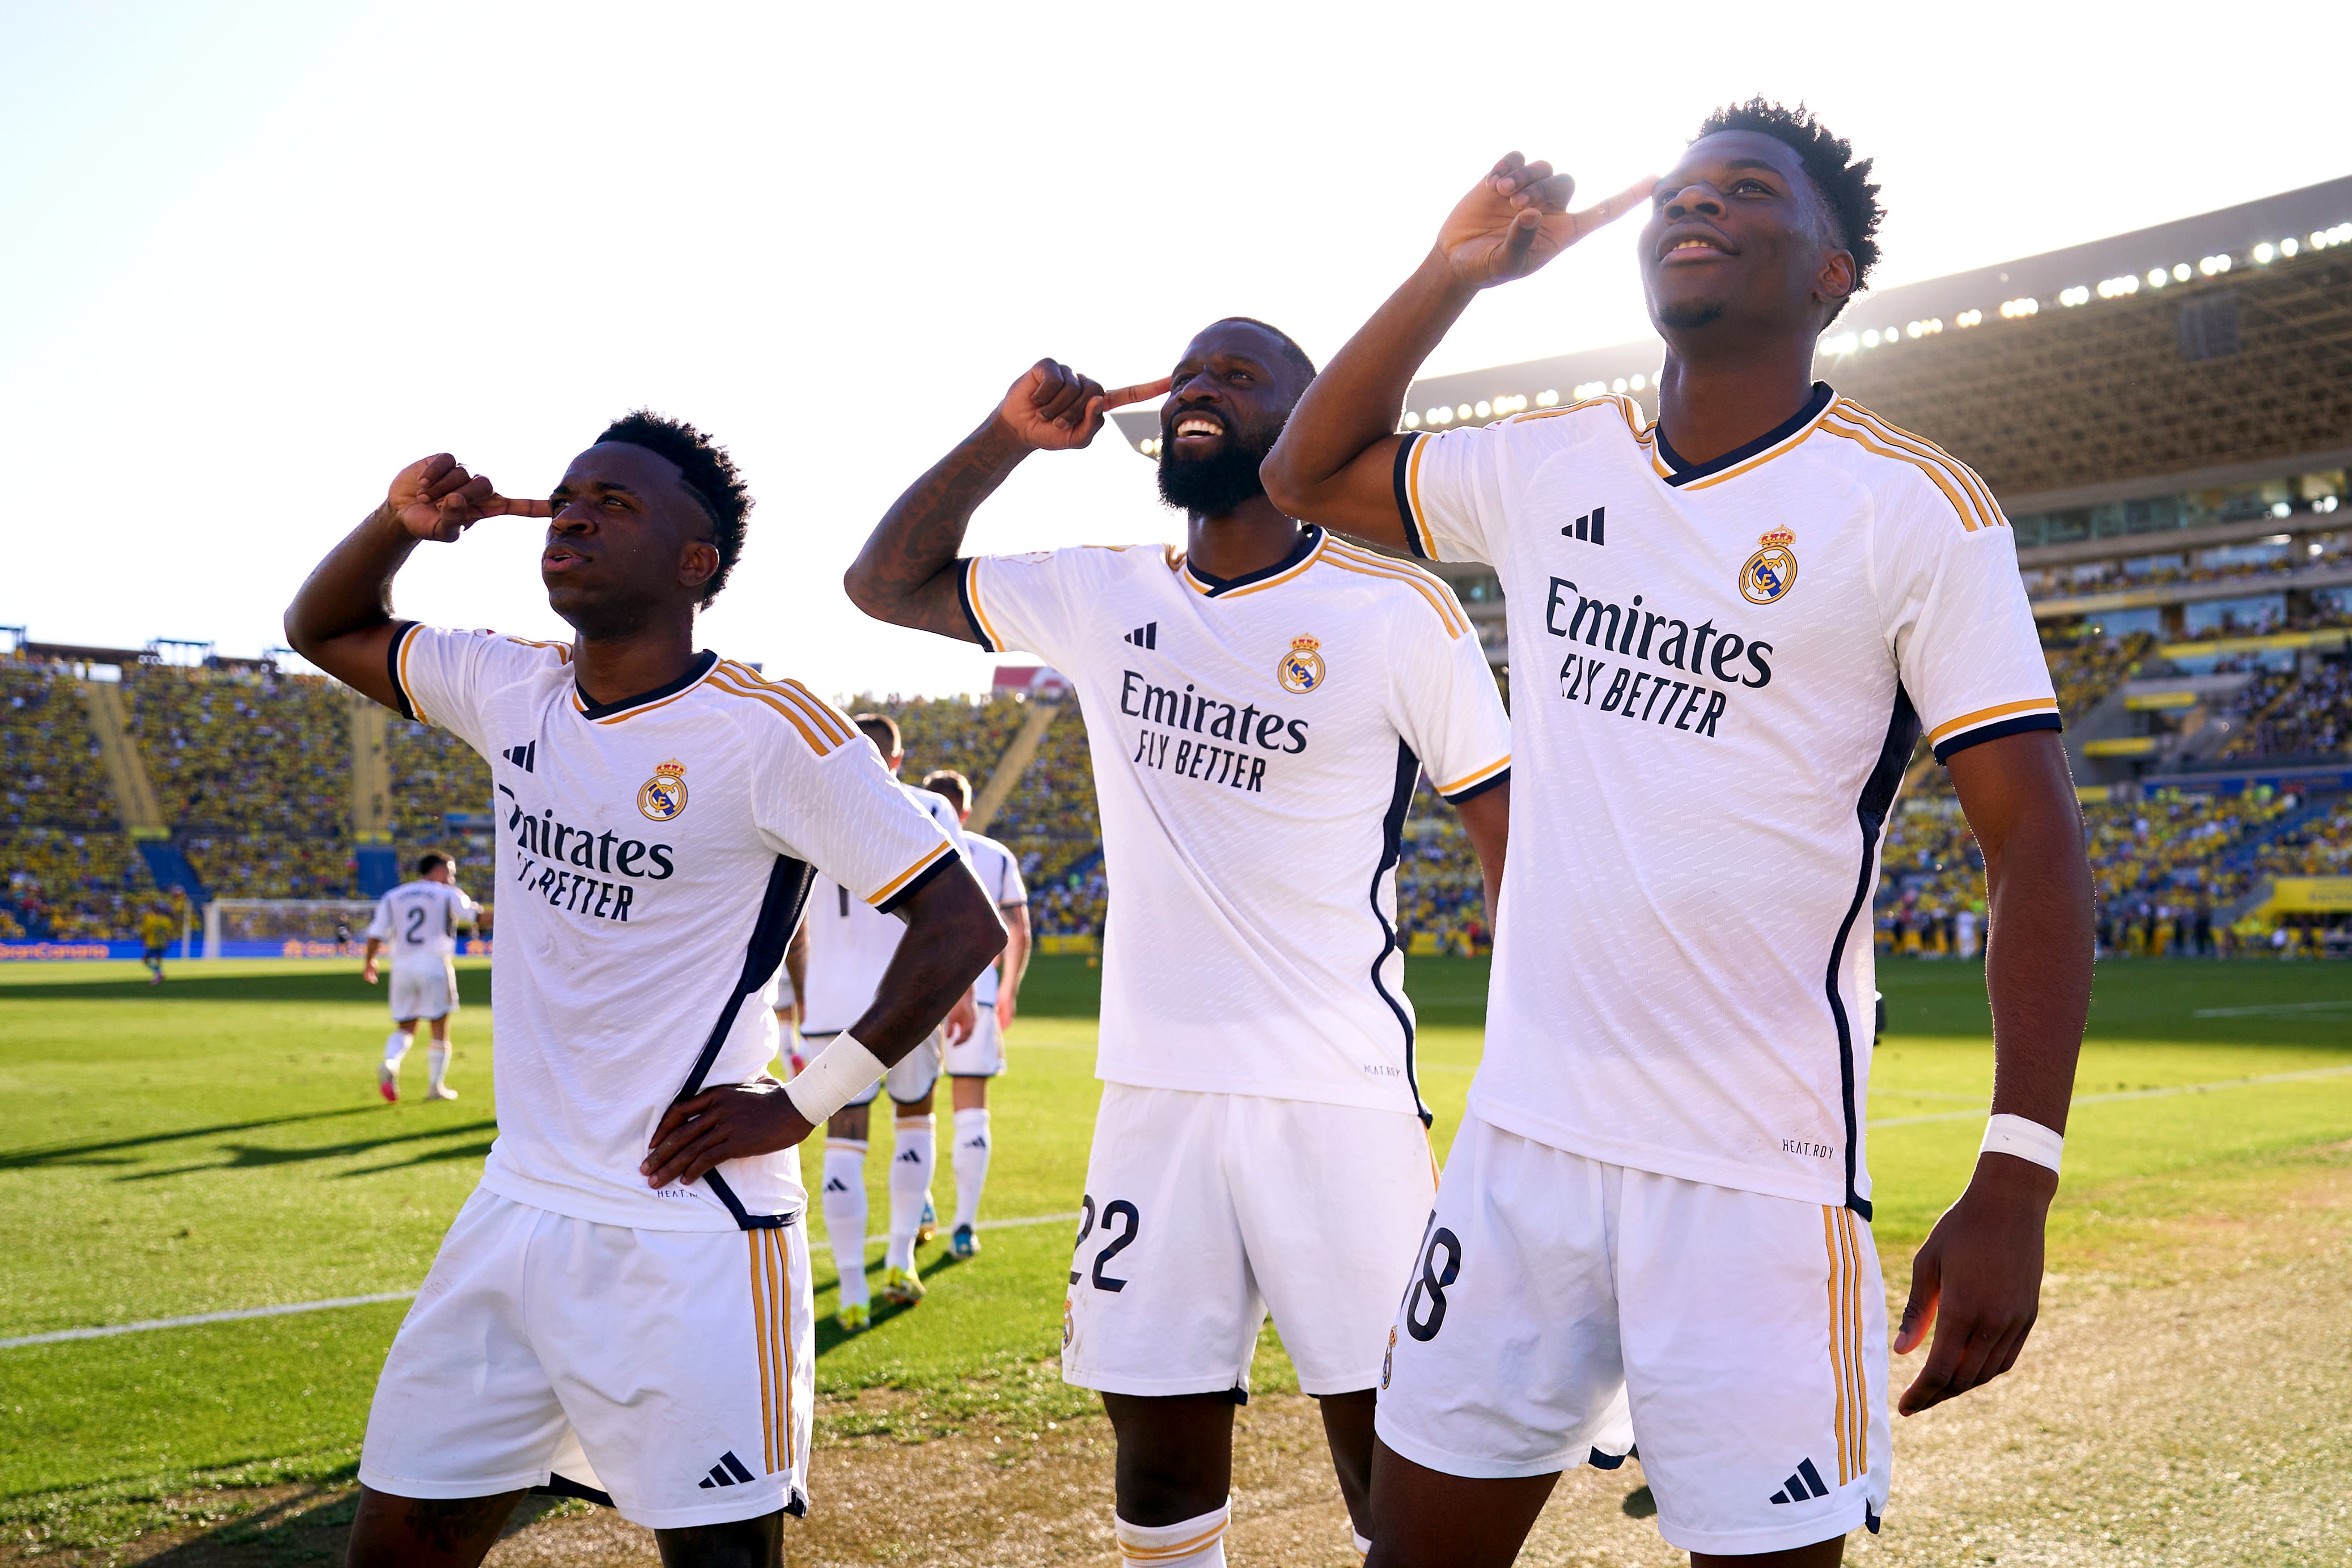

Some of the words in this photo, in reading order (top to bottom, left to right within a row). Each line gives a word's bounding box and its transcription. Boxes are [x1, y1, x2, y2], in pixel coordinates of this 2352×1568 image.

[1546, 576, 1773, 688] Emirates
[1121, 669, 1308, 754] Emirates
[1560, 654, 1606, 705] FLY
[1600, 668, 1727, 738] BETTER
[1134, 730, 1169, 769] FLY
[1175, 739, 1266, 793] BETTER
[406, 906, 426, 946] 2
[1783, 1139, 1834, 1159] HEAT.RDY
